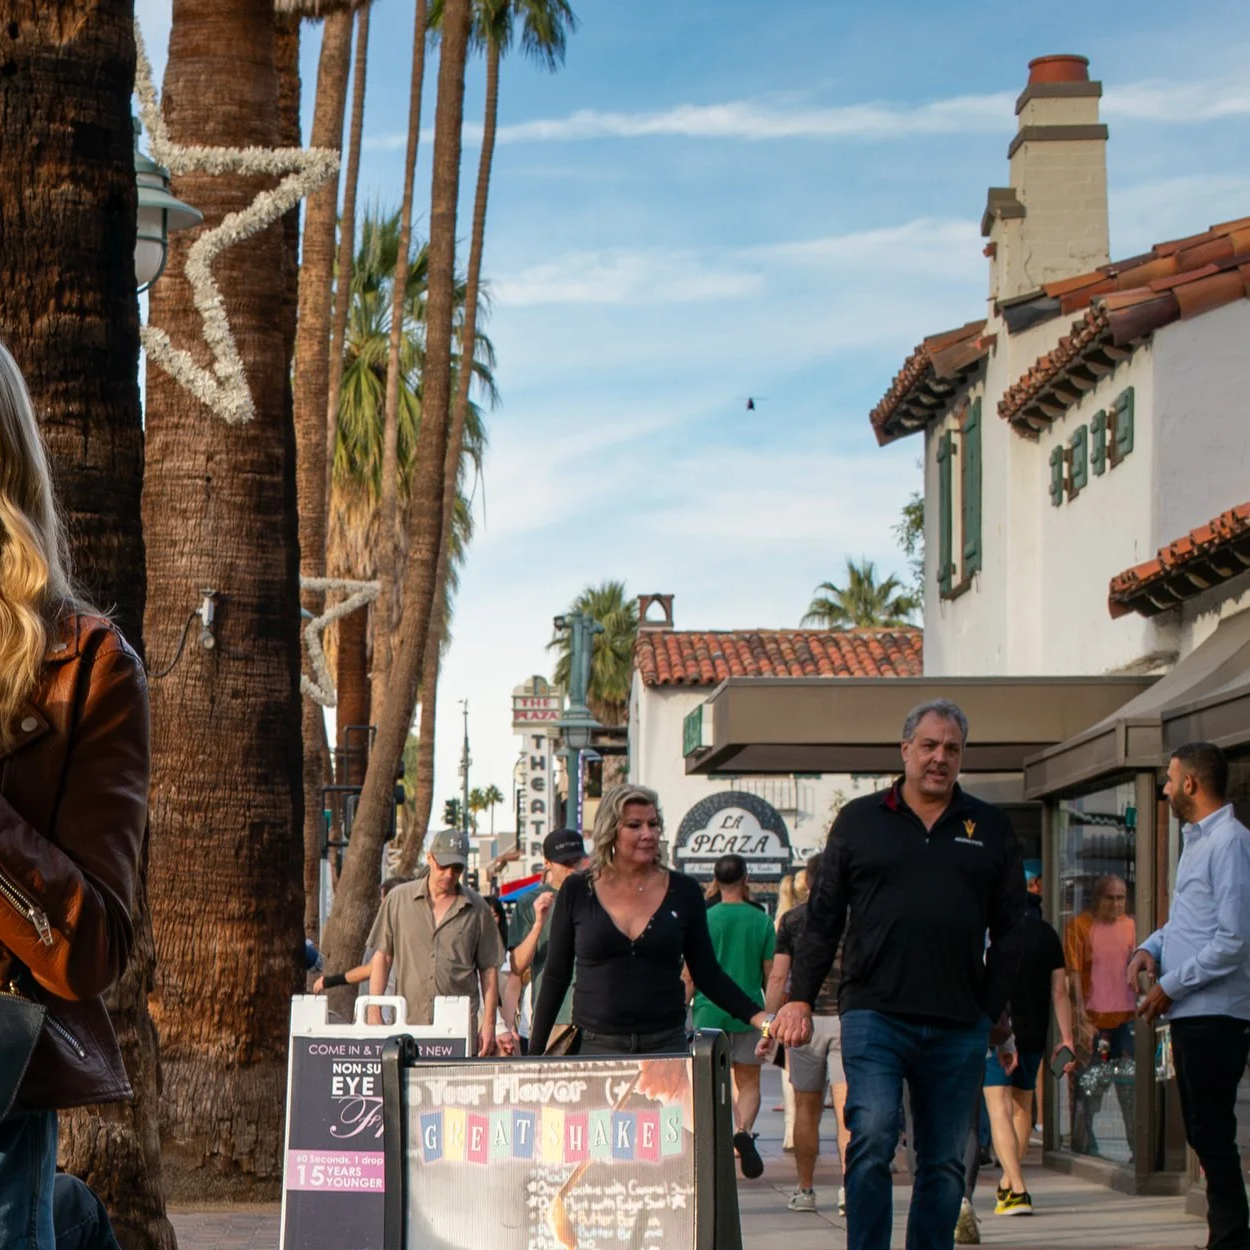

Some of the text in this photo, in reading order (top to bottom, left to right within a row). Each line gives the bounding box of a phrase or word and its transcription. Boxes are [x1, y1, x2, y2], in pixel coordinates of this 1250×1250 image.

[521, 698, 549, 707] THE
[514, 711, 558, 720] PLAZA
[720, 815, 745, 829] LA
[691, 834, 769, 853] PLAZA
[309, 1045, 346, 1055] COME
[348, 1045, 360, 1055] IN
[363, 1046, 372, 1055] &
[426, 1046, 453, 1056] NEW
[333, 1063, 381, 1074] NON-SU
[331, 1076, 374, 1095] EYE
[424, 1080, 486, 1105] Your
[493, 1076, 587, 1105] Flavor
[424, 1115, 680, 1152] GREAT SHAKES
[362, 1157, 383, 1166] drop
[297, 1165, 362, 1186] 15 YEARS
[326, 1177, 383, 1188] YOUNGER
